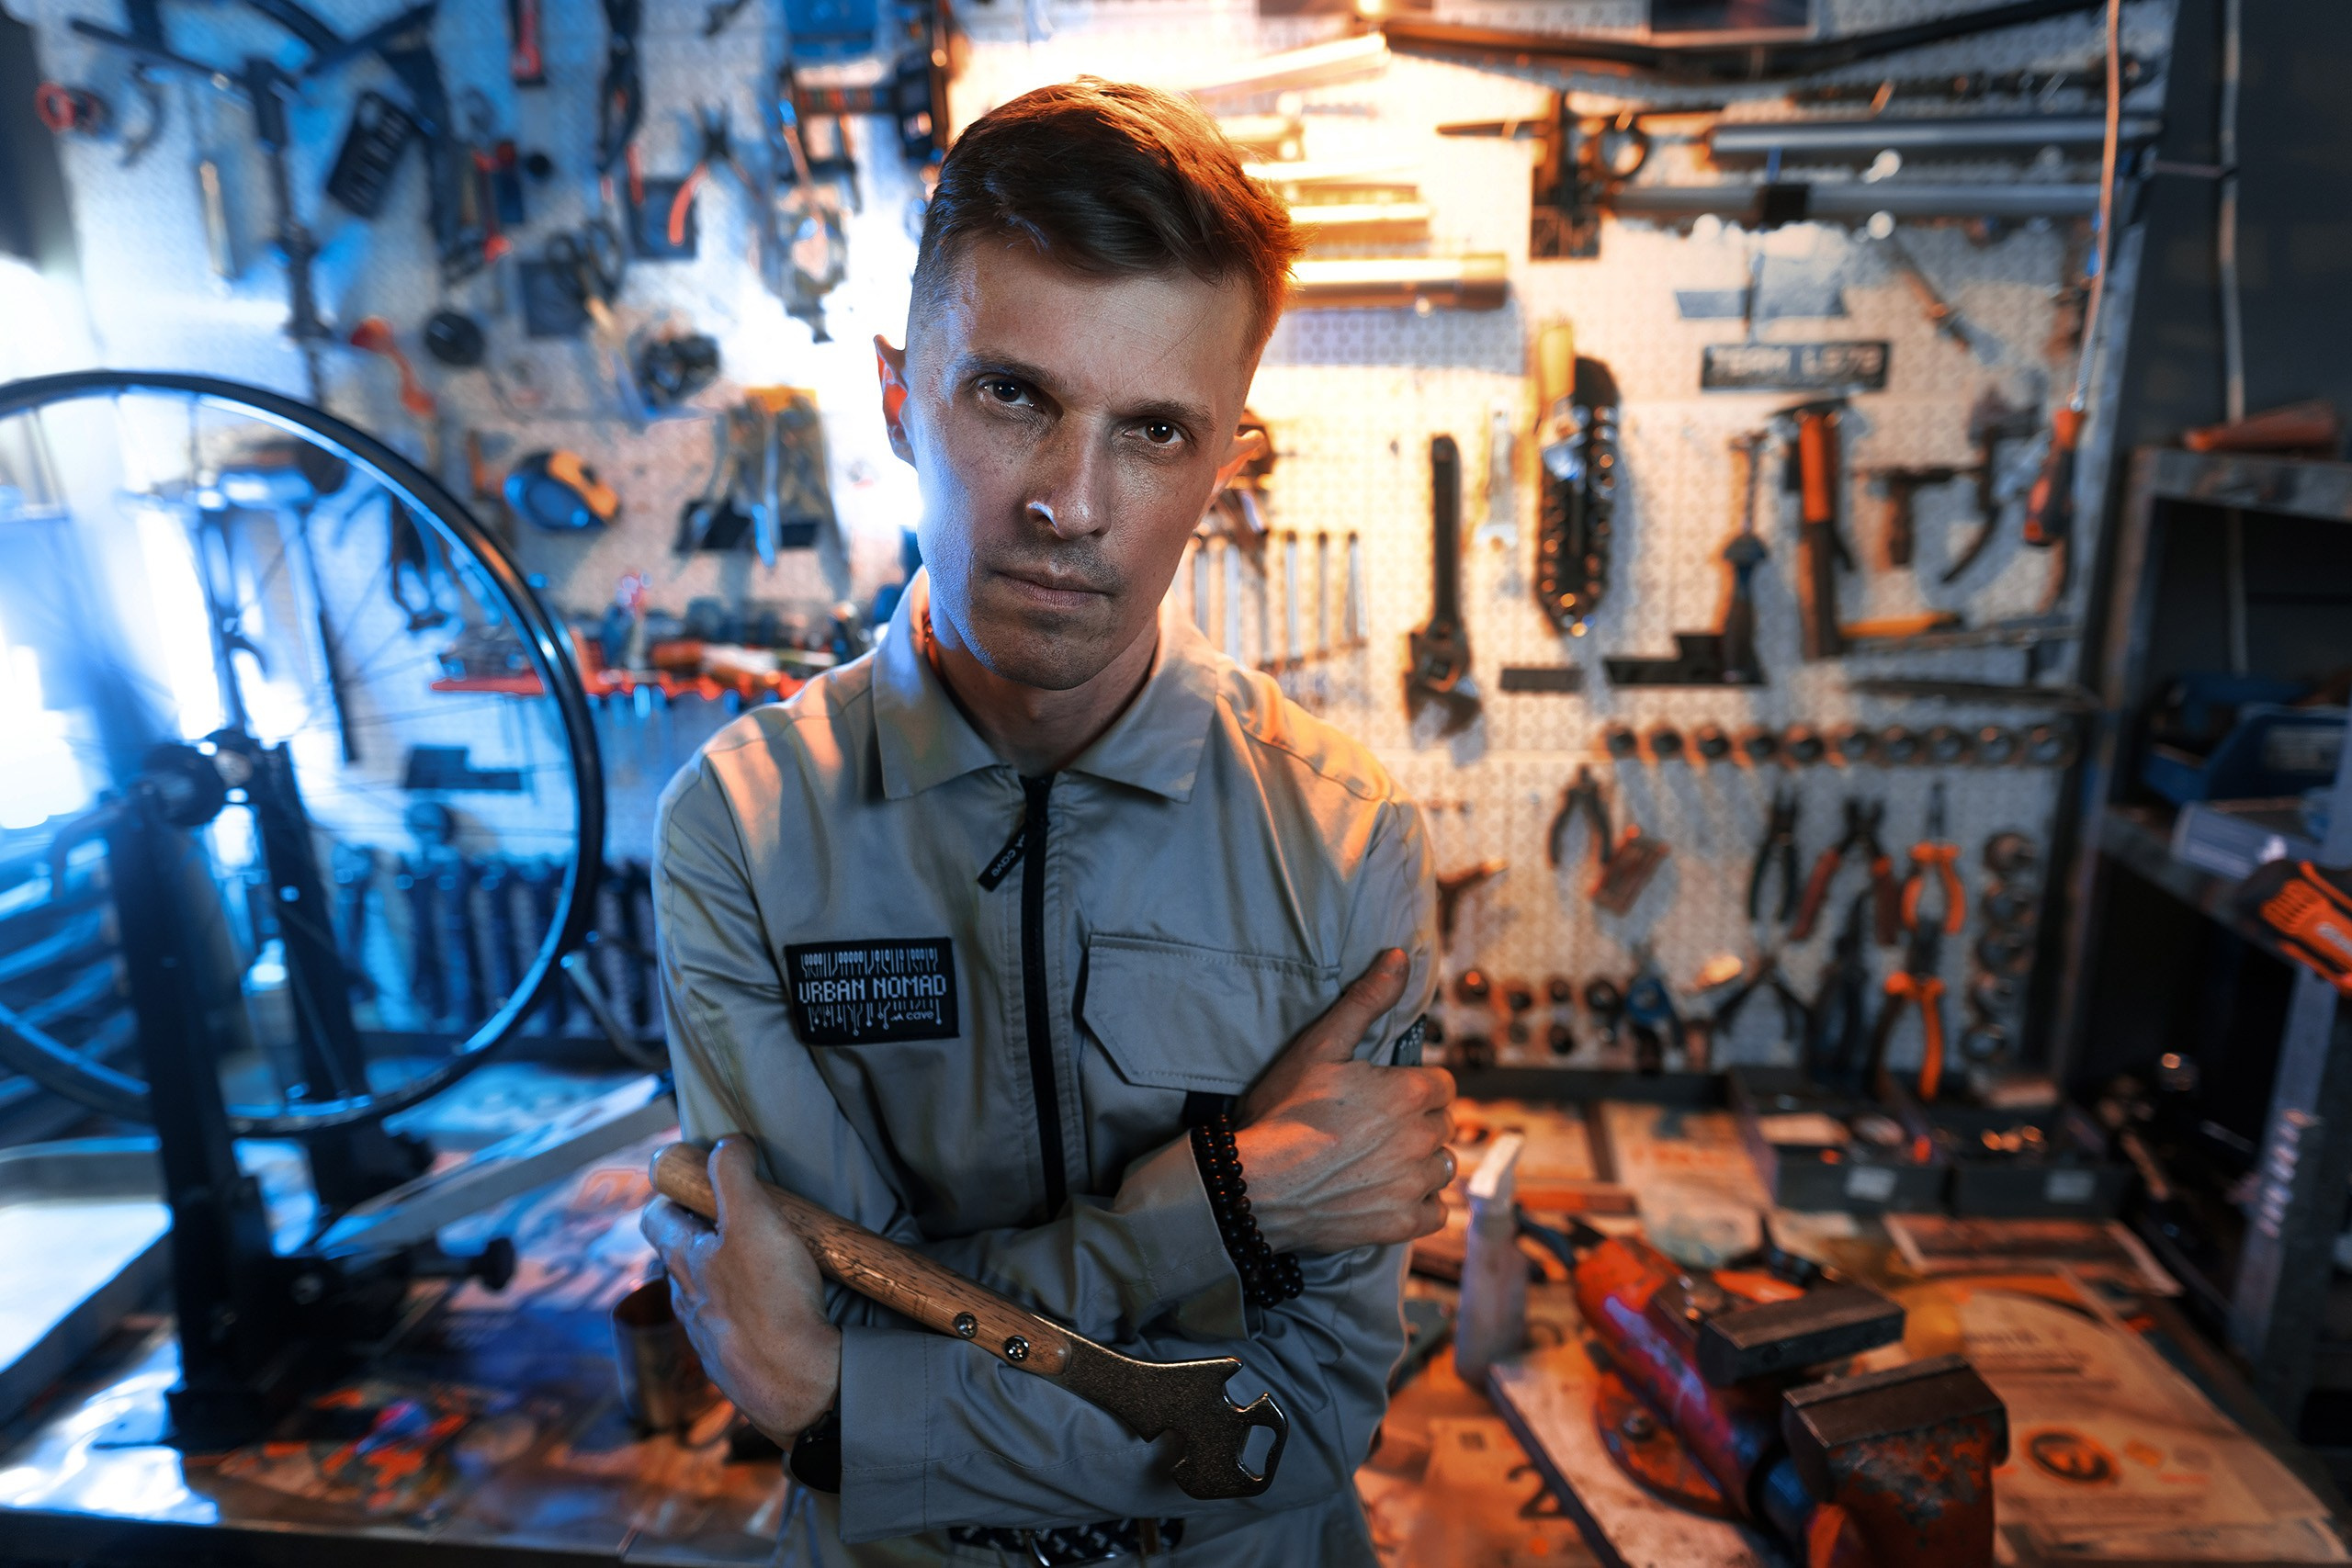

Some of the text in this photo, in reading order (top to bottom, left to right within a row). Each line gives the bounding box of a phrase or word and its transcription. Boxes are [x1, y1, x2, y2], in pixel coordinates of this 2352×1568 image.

[1713, 346, 1787, 372] TEAM
[990, 849, 1017, 876] cave
[798, 974, 947, 1004] URBAN NOMAD
[905, 1010, 935, 1021] cave
